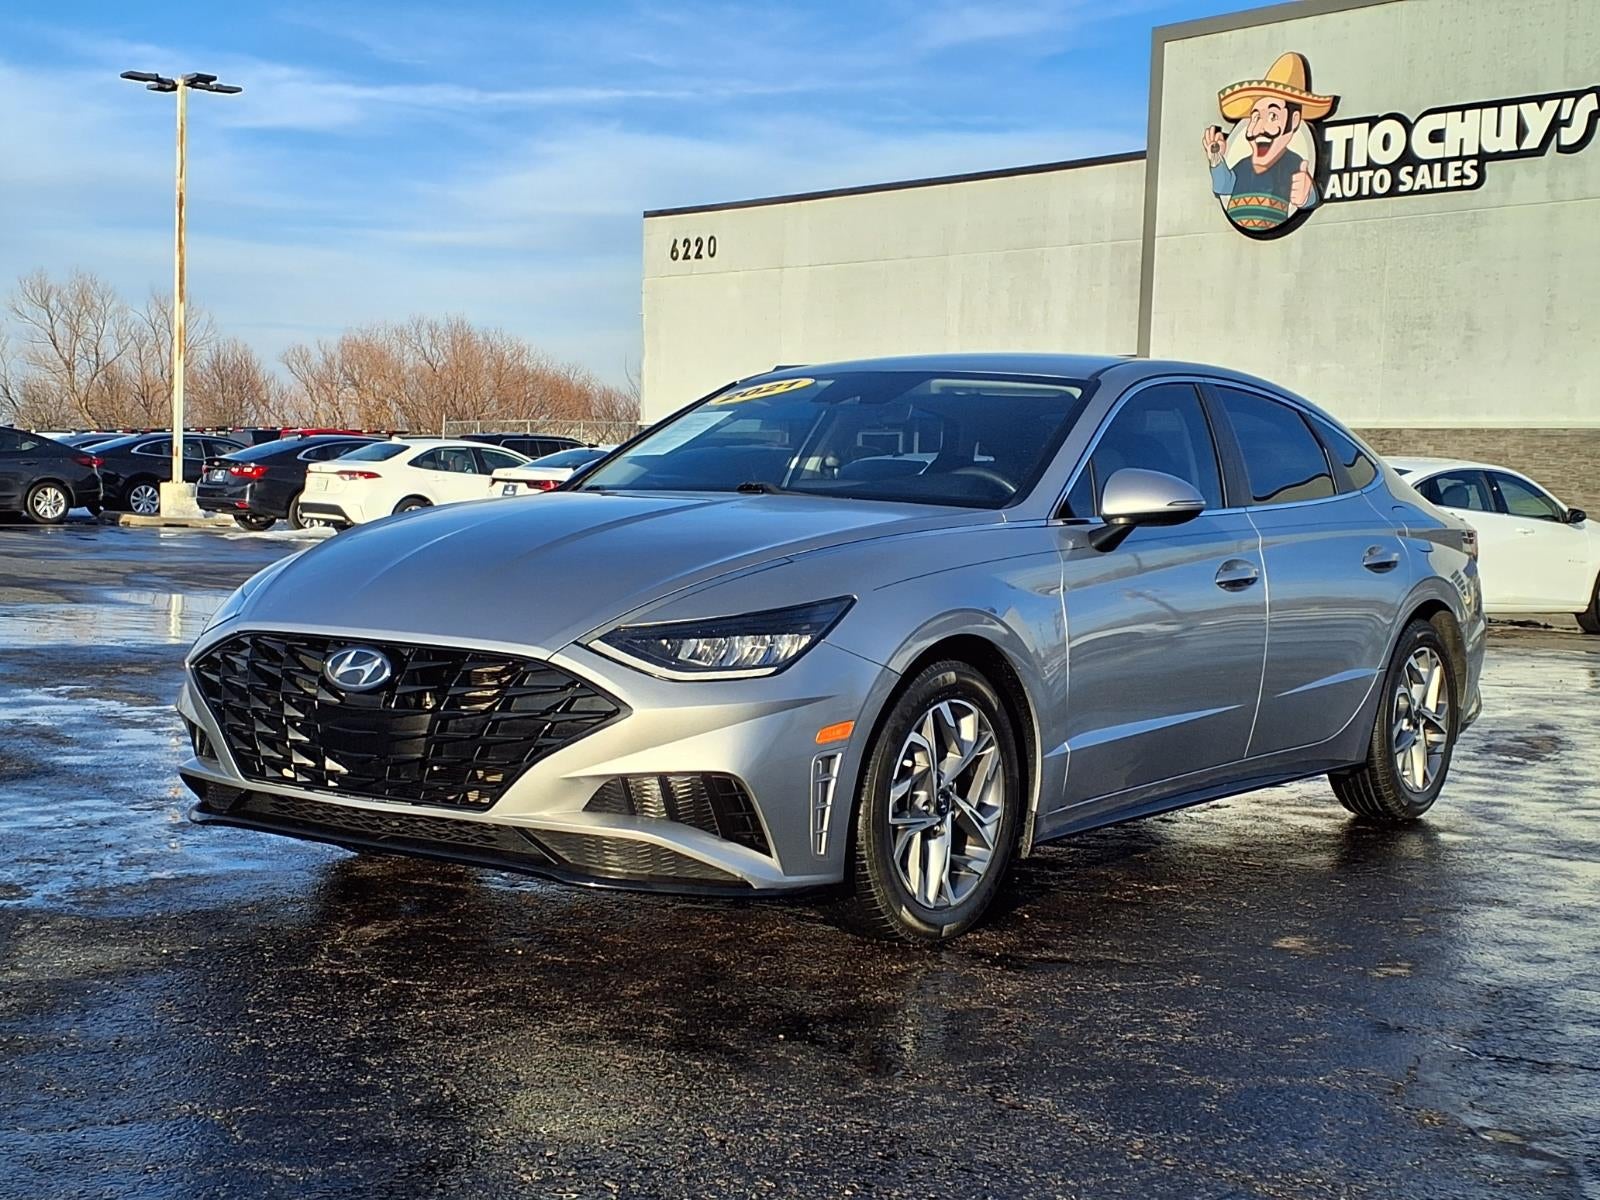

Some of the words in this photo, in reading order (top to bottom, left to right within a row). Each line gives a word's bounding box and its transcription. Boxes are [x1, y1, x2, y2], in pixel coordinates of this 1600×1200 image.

[1325, 119, 1406, 170] TIO
[1411, 93, 1598, 160] CHUY'S
[1324, 169, 1392, 199] AUTO
[1399, 160, 1478, 192] SALES
[670, 235, 717, 261] 6220
